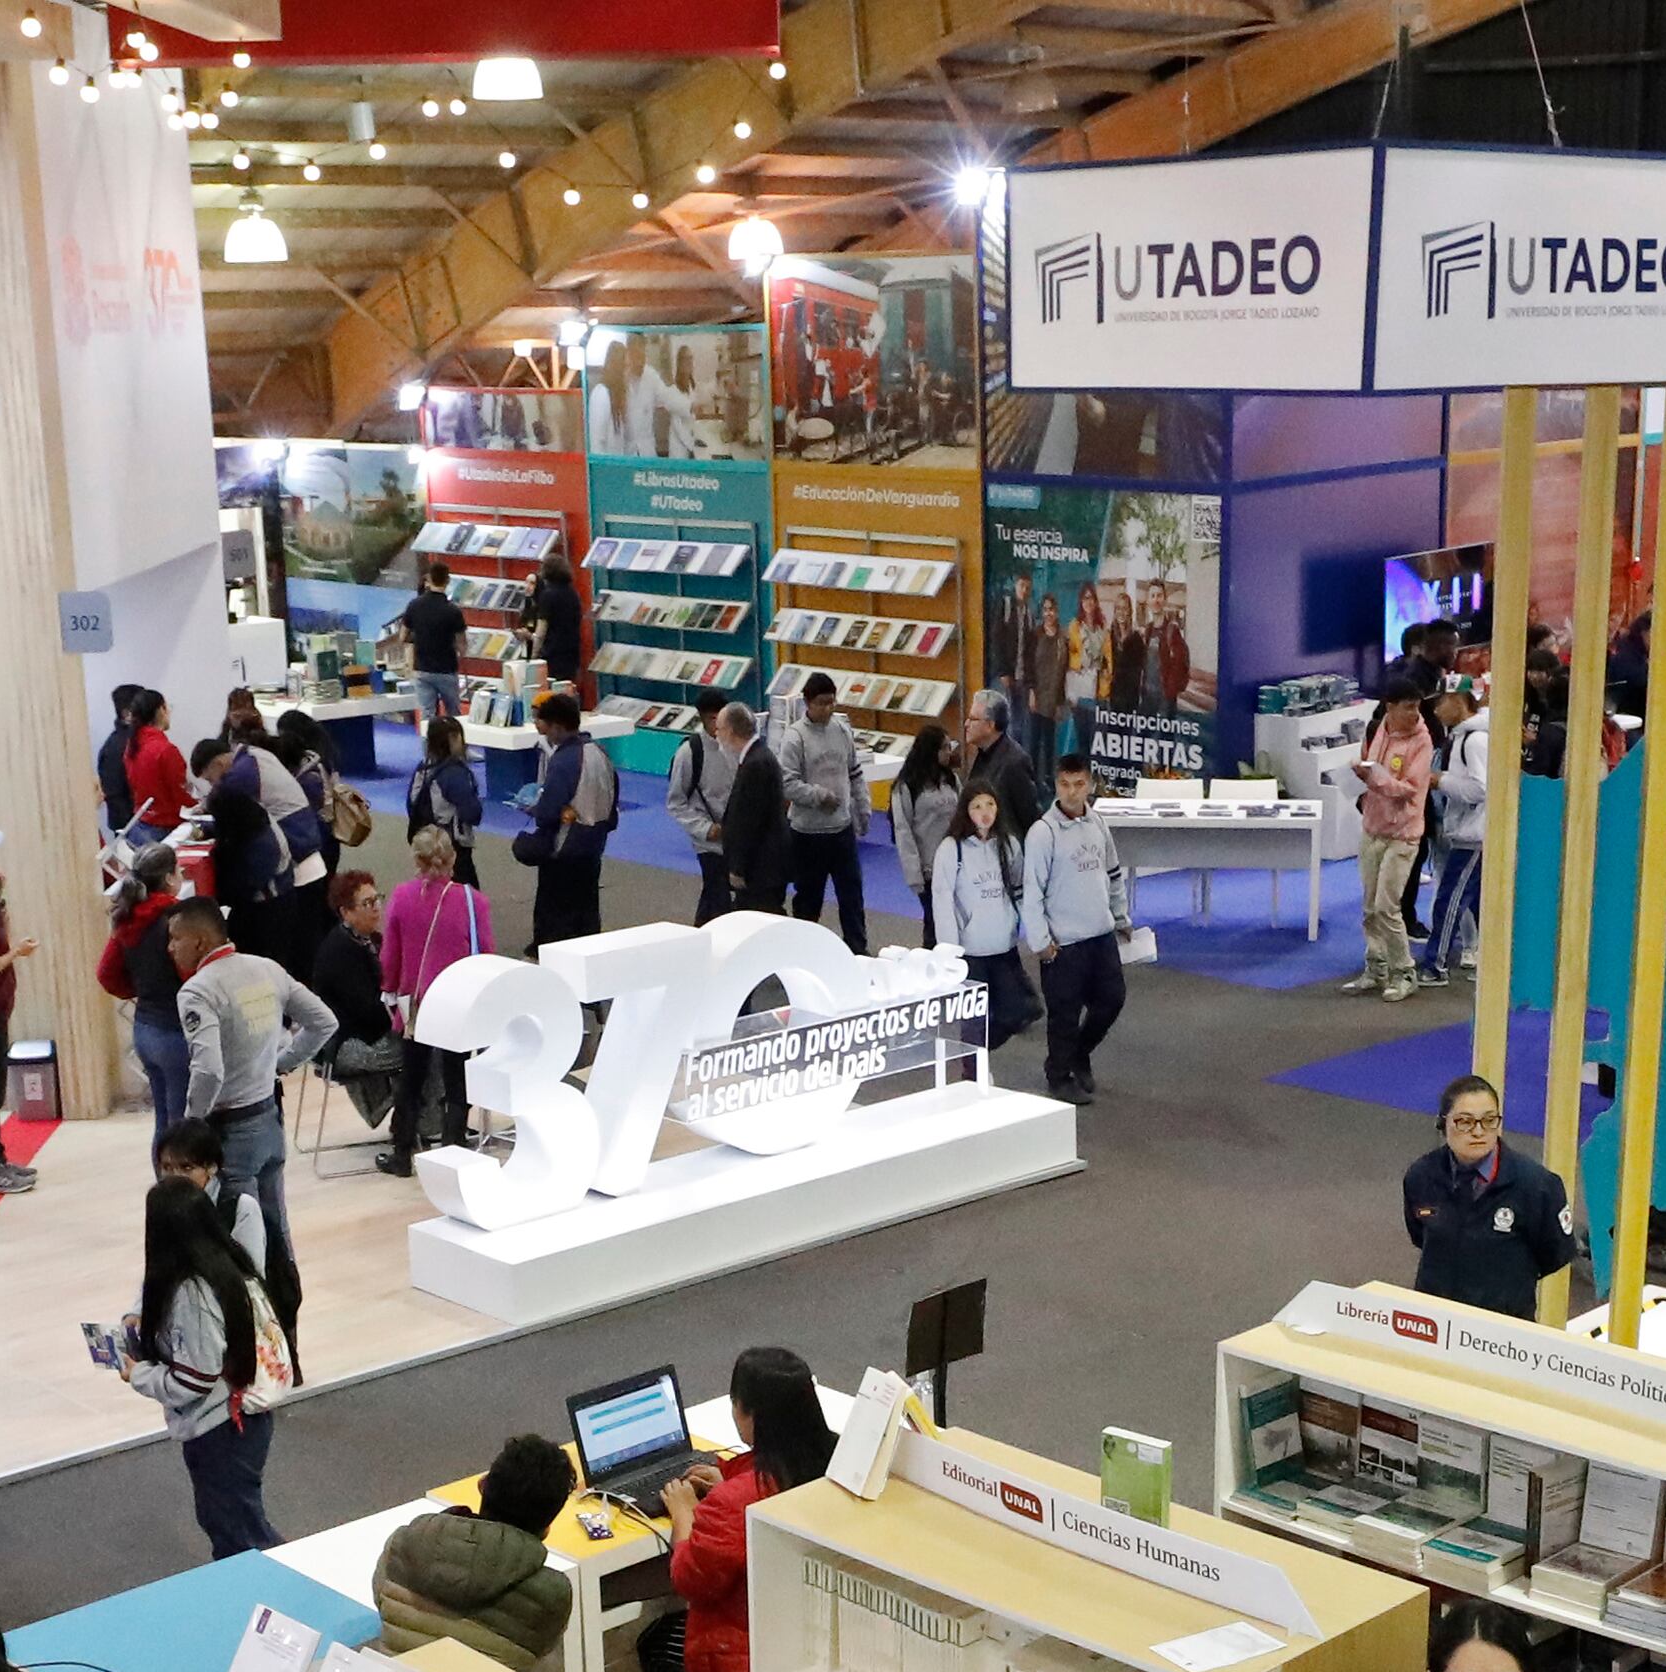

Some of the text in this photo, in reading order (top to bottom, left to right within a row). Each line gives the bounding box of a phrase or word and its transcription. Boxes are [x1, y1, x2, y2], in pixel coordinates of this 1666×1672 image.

[1114, 235, 1321, 301] UTADEO
[1281, 307, 1320, 320] LOZANO
[633, 472, 720, 492] #LibrosUtadeo
[650, 493, 703, 513] #UTadeo
[793, 484, 960, 509] #EducaciónDeVanguardia
[995, 523, 1063, 546] Tu esencia
[1013, 543, 1090, 565] NOS INSPIRA
[69, 615, 101, 632] 302
[1094, 705, 1201, 738] Inscripciones
[1090, 731, 1204, 771] ABIERTAS
[1090, 761, 1142, 782] Pregrado
[686, 986, 989, 1087] Formando proyectos de vida
[687, 1041, 887, 1122] al servicio del país
[1336, 1300, 1389, 1326] Librería
[1397, 1316, 1434, 1338] UNAL
[1459, 1329, 1529, 1364] Derecho
[1532, 1352, 1544, 1372] y
[1547, 1352, 1616, 1388] Ciencias
[941, 1460, 1221, 1582] Editorial UNAL Ciencias Humanas
